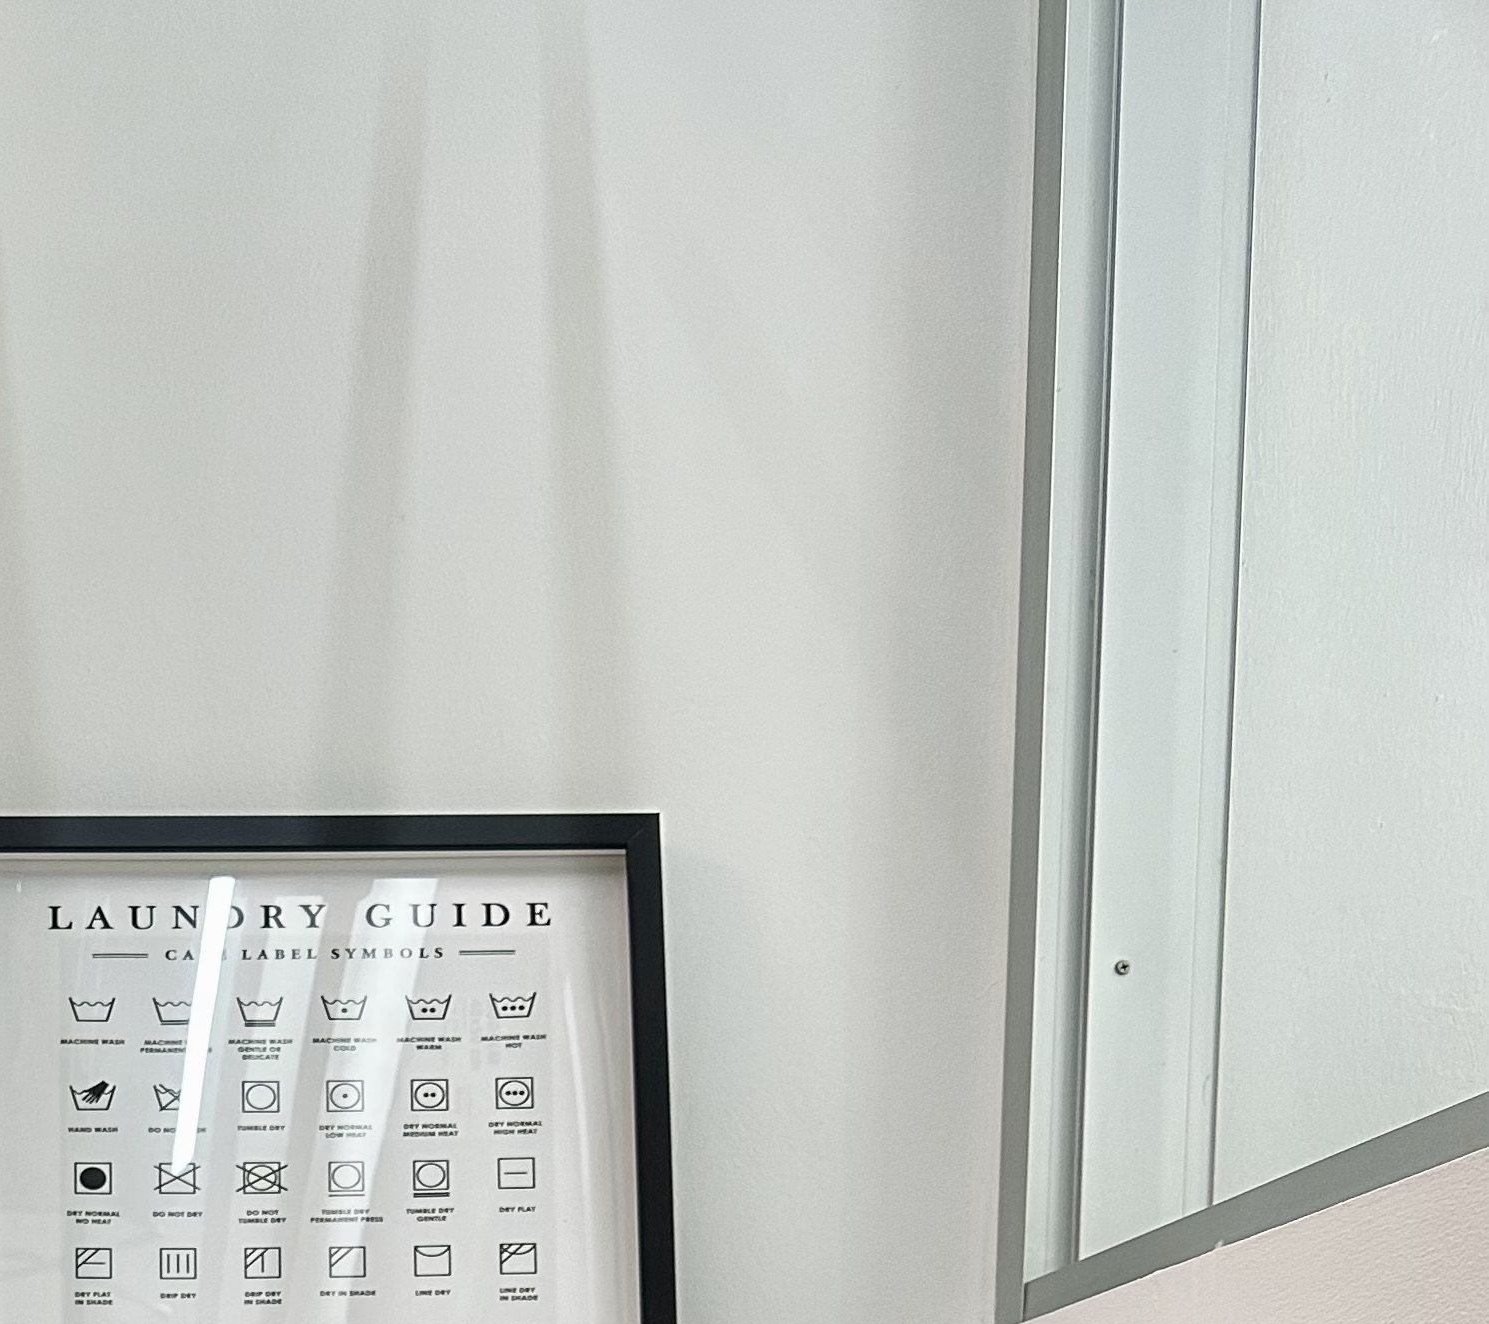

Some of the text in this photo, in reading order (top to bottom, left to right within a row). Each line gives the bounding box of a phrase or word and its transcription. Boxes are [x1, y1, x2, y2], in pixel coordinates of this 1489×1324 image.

[365, 902, 552, 928] GUIDE
[242, 948, 318, 961] LABEL
[330, 947, 444, 960] SYMBOLS
